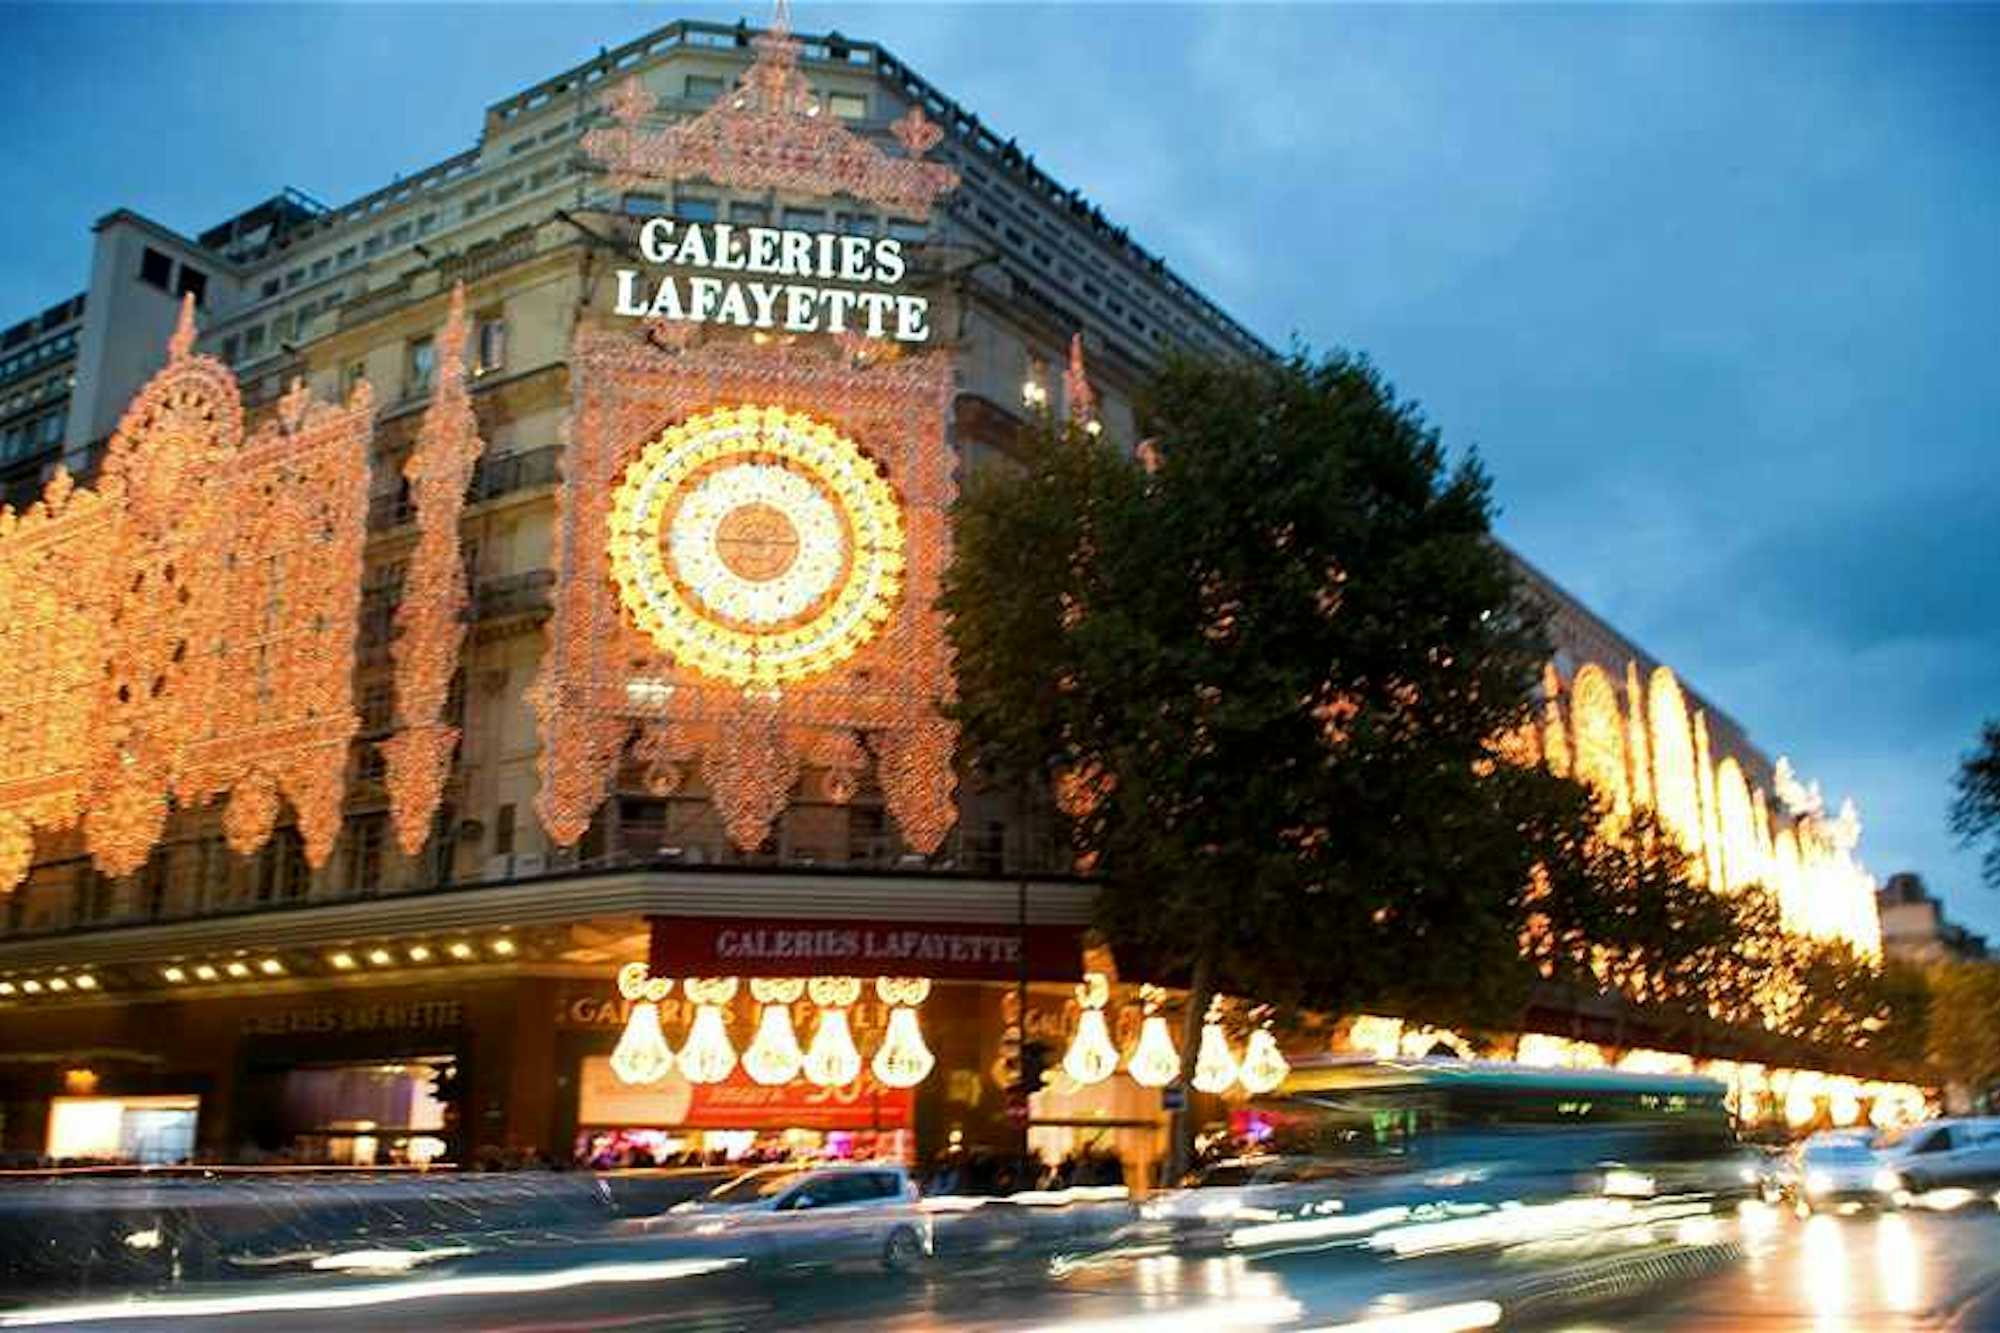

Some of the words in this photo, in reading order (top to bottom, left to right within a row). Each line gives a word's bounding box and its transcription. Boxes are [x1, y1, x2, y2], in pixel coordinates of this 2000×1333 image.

[639, 218, 906, 284] GALERIES
[613, 270, 930, 342] LAFAYETTE
[716, 929, 859, 959] GALERIES
[864, 930, 1023, 963] LAFAYETTE
